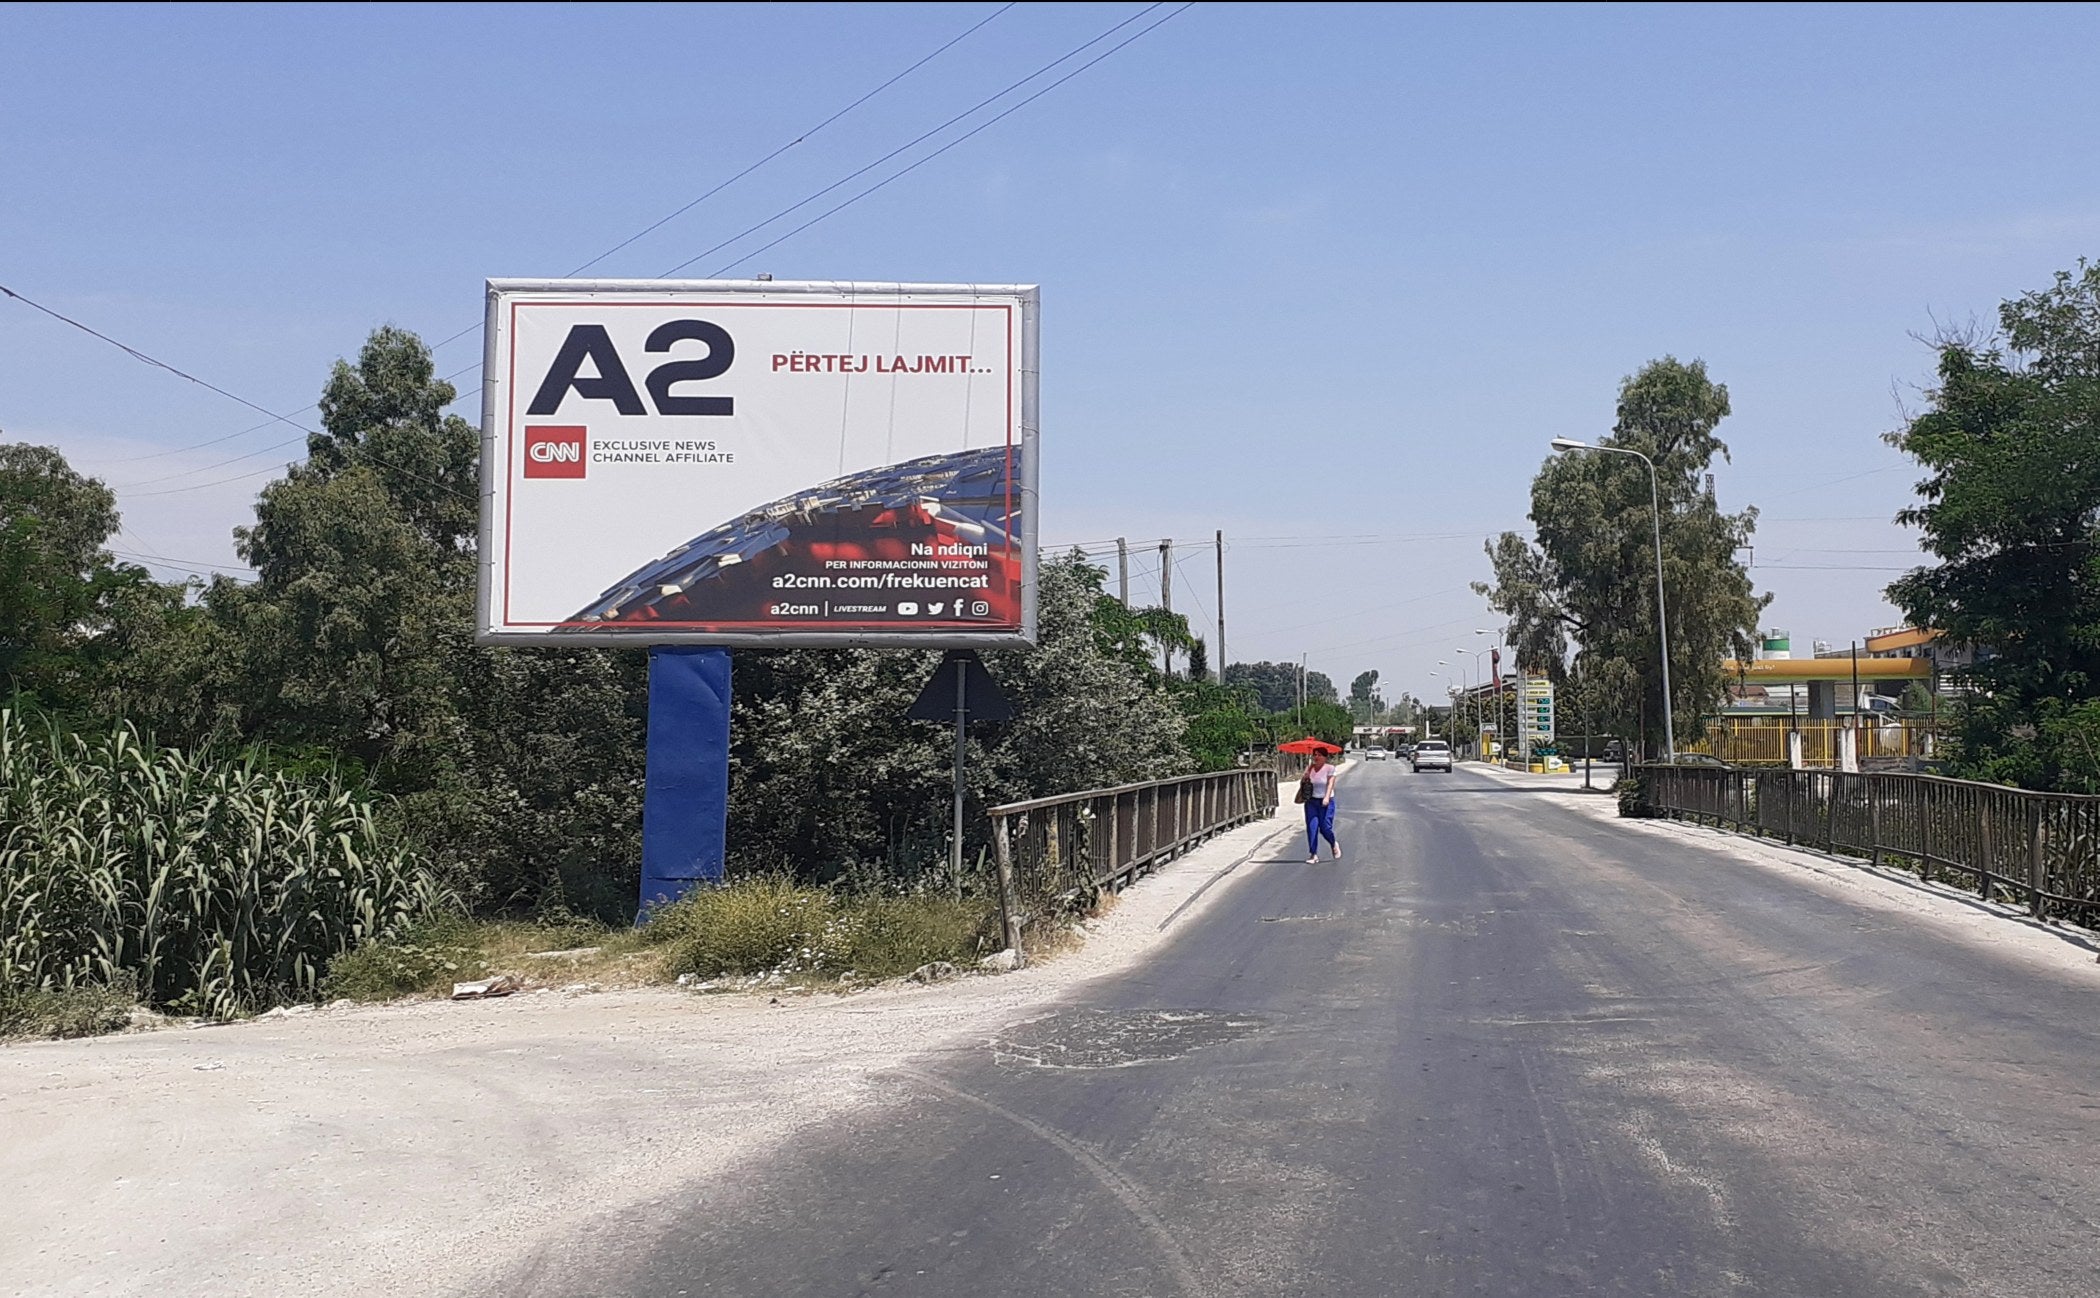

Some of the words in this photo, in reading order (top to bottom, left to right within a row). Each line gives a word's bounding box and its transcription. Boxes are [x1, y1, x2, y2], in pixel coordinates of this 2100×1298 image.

[525, 319, 735, 416] A2
[771, 350, 868, 373] PËRTEJ
[876, 355, 992, 373] LAJMIT...
[530, 441, 580, 462] CNN
[593, 441, 670, 451] EXCLUSIVE
[675, 441, 716, 451] NEWS
[592, 453, 661, 463] CHANNEL
[665, 453, 734, 463] AFFILIATE
[910, 543, 933, 556] Na
[937, 542, 988, 558] ndiqni
[825, 560, 847, 569] PER
[850, 560, 938, 569] INFORMACIONIN
[941, 560, 988, 569] VIZITONI
[772, 573, 988, 589] a2cnn.com/frekuencat
[770, 602, 819, 615] a2cnn
[833, 605, 887, 613] LIVESTREAM
